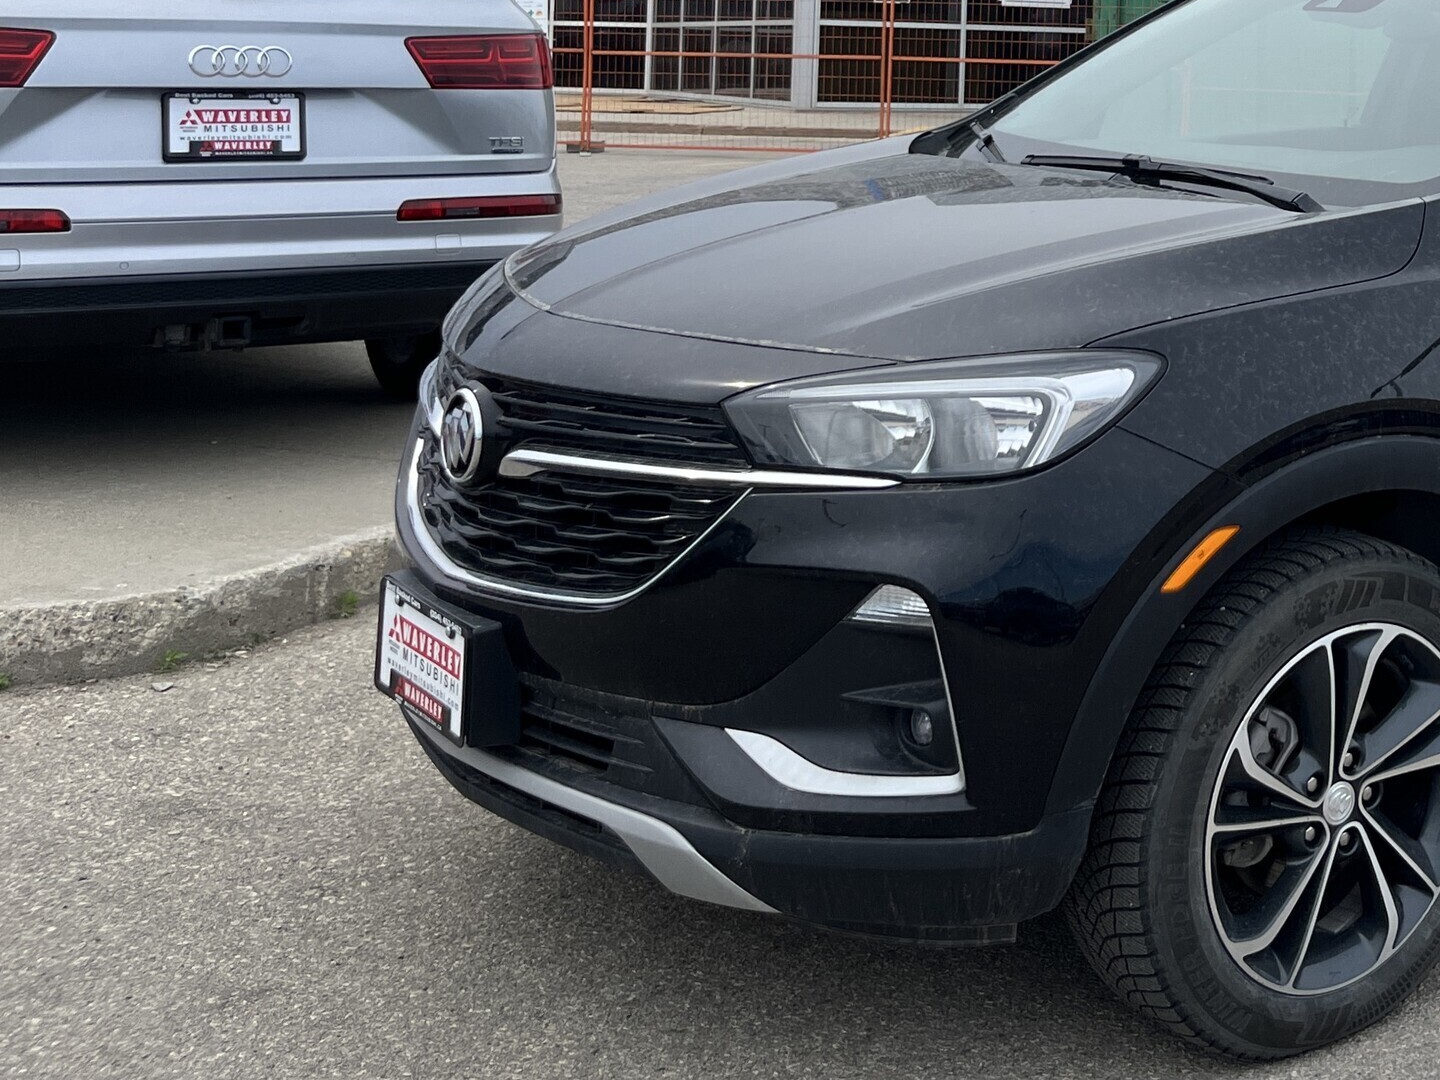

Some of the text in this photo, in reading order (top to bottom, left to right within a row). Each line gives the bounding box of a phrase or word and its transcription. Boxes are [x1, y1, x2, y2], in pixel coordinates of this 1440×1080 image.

[202, 111, 289, 122] WAVERLEY
[204, 124, 290, 132] MITSUBISHI
[214, 141, 273, 150] WAVERLEY
[402, 620, 460, 677] WAVERLEY
[402, 647, 459, 696] MITSUBISHI
[404, 682, 443, 719] WAVERLEY
